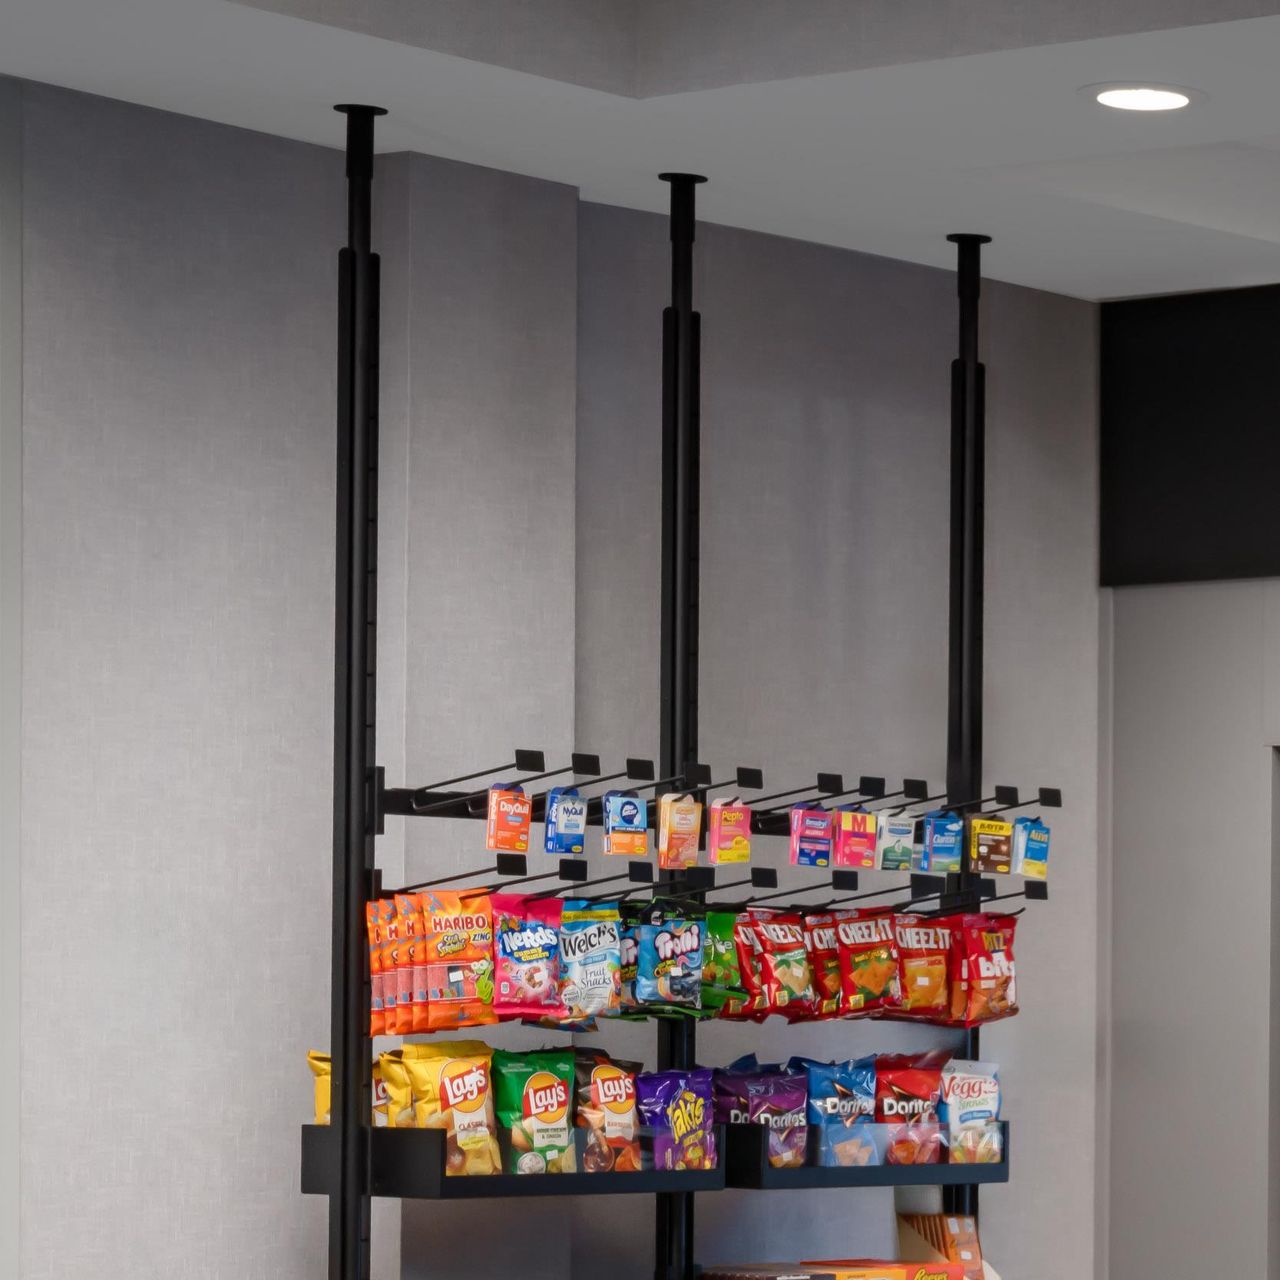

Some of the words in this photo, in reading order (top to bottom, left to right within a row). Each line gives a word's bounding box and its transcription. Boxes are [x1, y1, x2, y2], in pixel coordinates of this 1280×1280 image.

[499, 801, 530, 815] DayQuil
[562, 806, 584, 818] NyQuil
[722, 811, 744, 823] Pepto
[432, 914, 487, 932] HARIBO
[837, 918, 894, 945] CHEEZ-IT
[561, 923, 618, 958] Welch's
[896, 926, 951, 949] CHEEZ-IT
[580, 975, 613, 989] Snacks
[584, 968, 606, 980] Fruit
[443, 1067, 486, 1105] Lay's
[598, 1074, 634, 1103] Lay's
[529, 1083, 567, 1114] Lay's
[760, 1108, 806, 1128] Doritos
